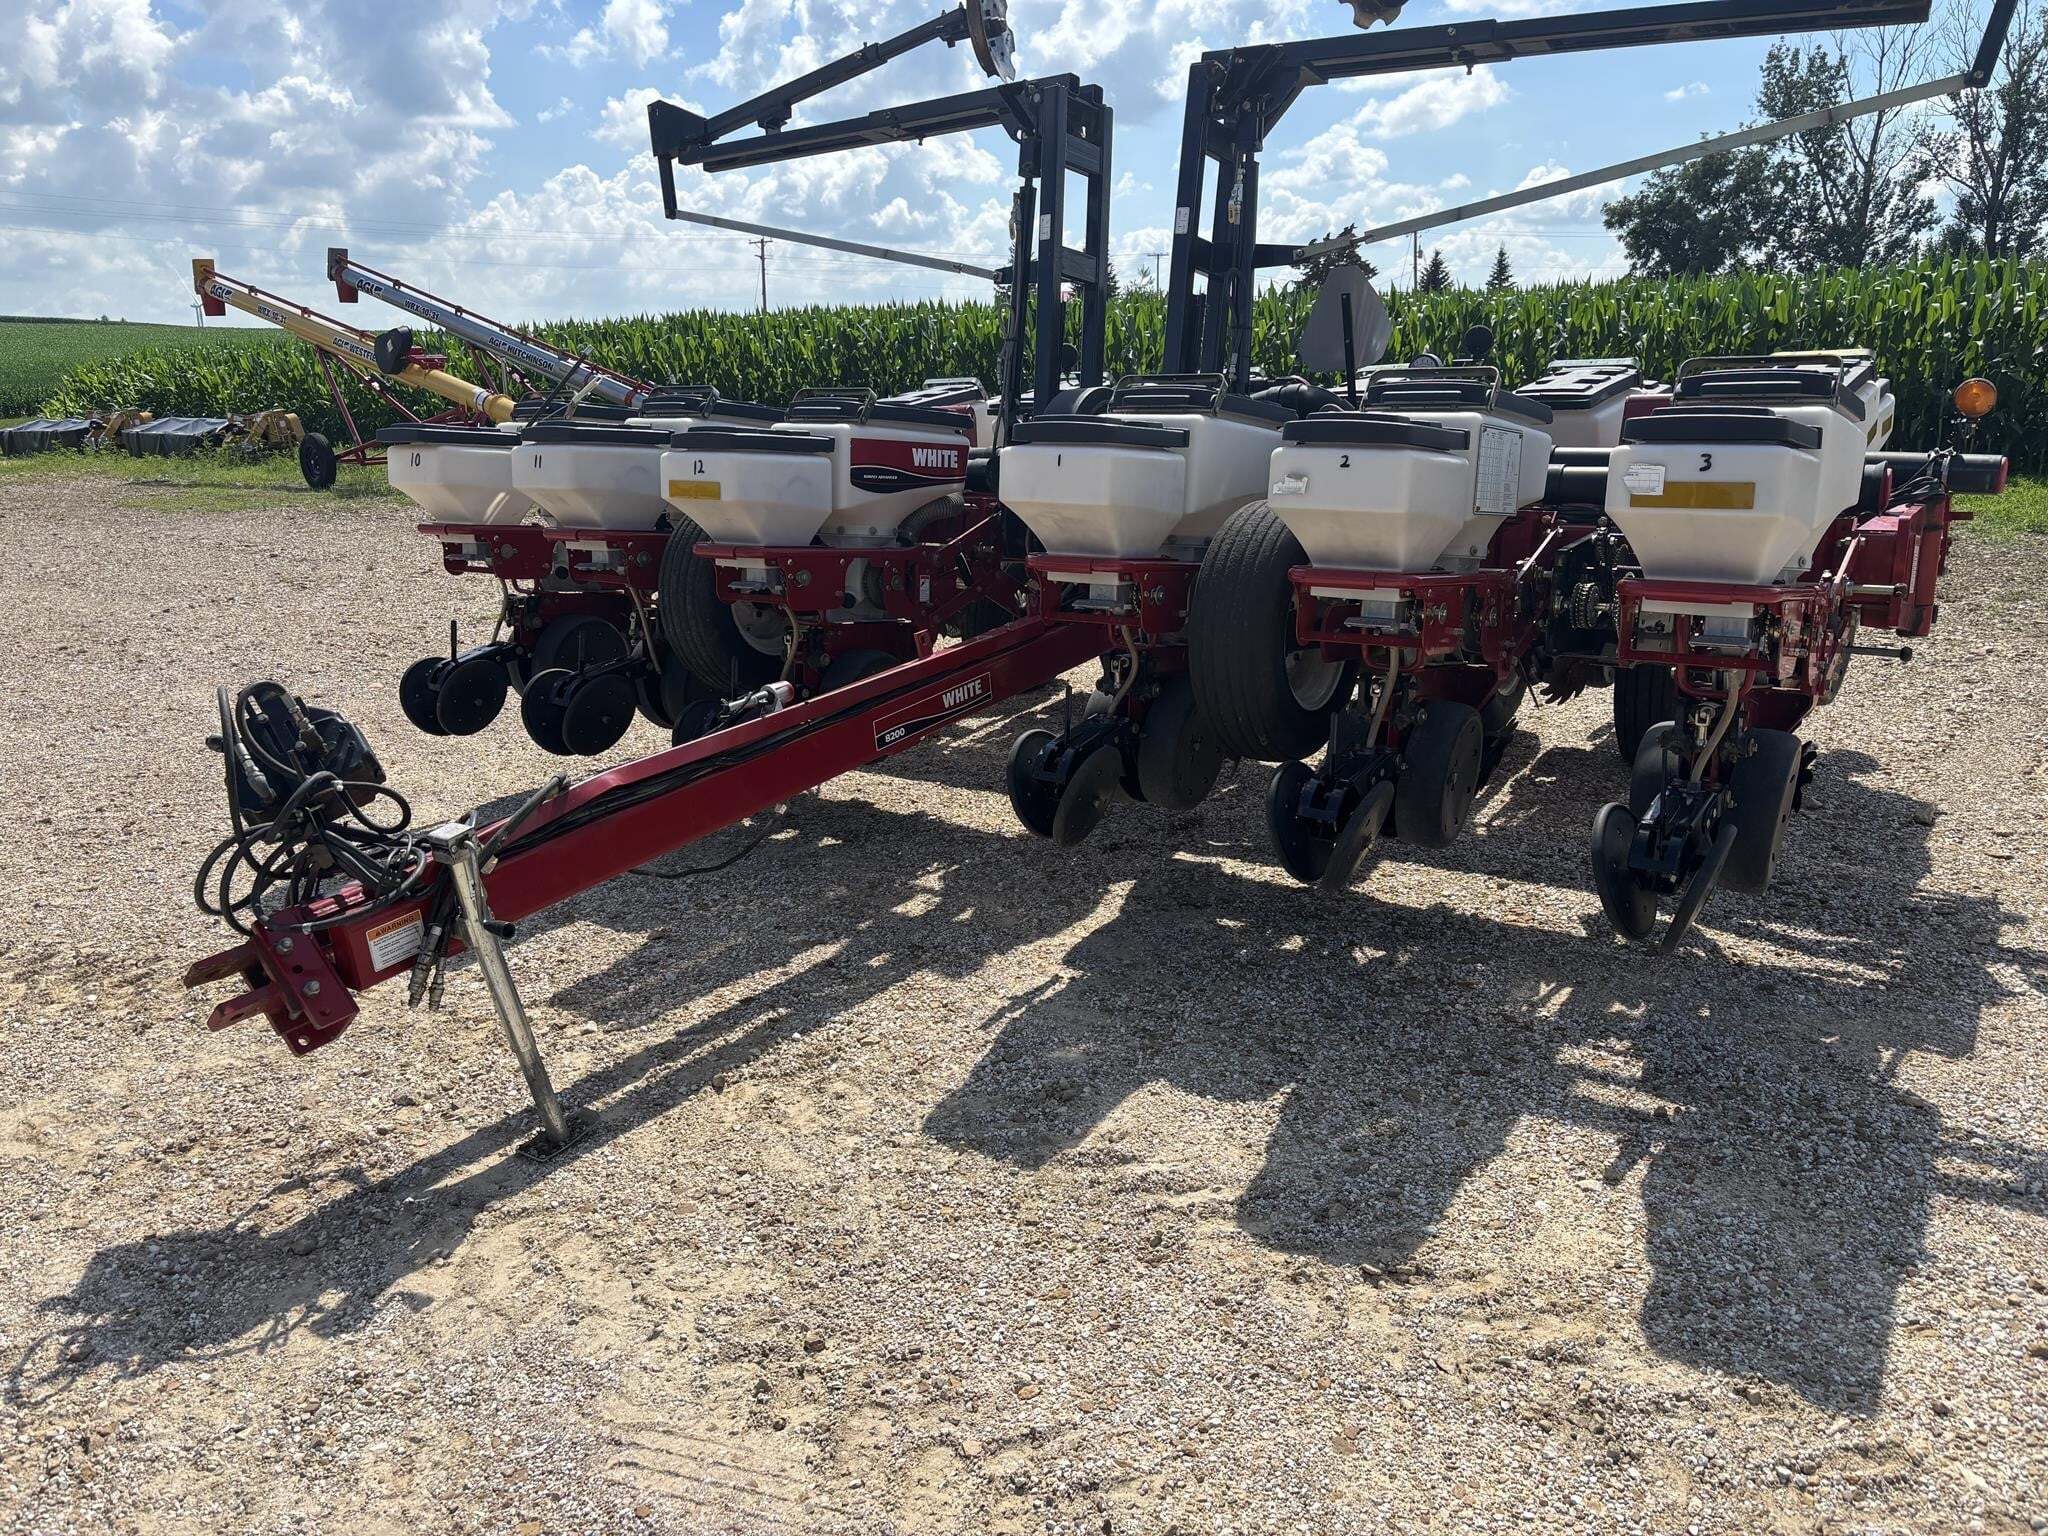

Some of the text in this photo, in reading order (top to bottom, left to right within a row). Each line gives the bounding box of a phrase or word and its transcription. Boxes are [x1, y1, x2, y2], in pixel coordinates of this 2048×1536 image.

[210, 284, 227, 300] AGI
[356, 279, 375, 295] AGI
[257, 305, 271, 318] WRX
[404, 300, 440, 320] WRX 10-31
[332, 337, 344, 348] AGI
[488, 336, 554, 371] AGI HUTCHINSON
[410, 452, 421, 467] 10
[534, 454, 542, 469] 11
[911, 448, 959, 469] WHITE
[1057, 453, 1062, 468] 1
[1339, 454, 1351, 468] 2
[1699, 452, 1713, 472] 3
[693, 459, 705, 475] 12
[942, 679, 983, 709] WHITE
[884, 727, 906, 743] 8200
[380, 915, 415, 934] WARNING
